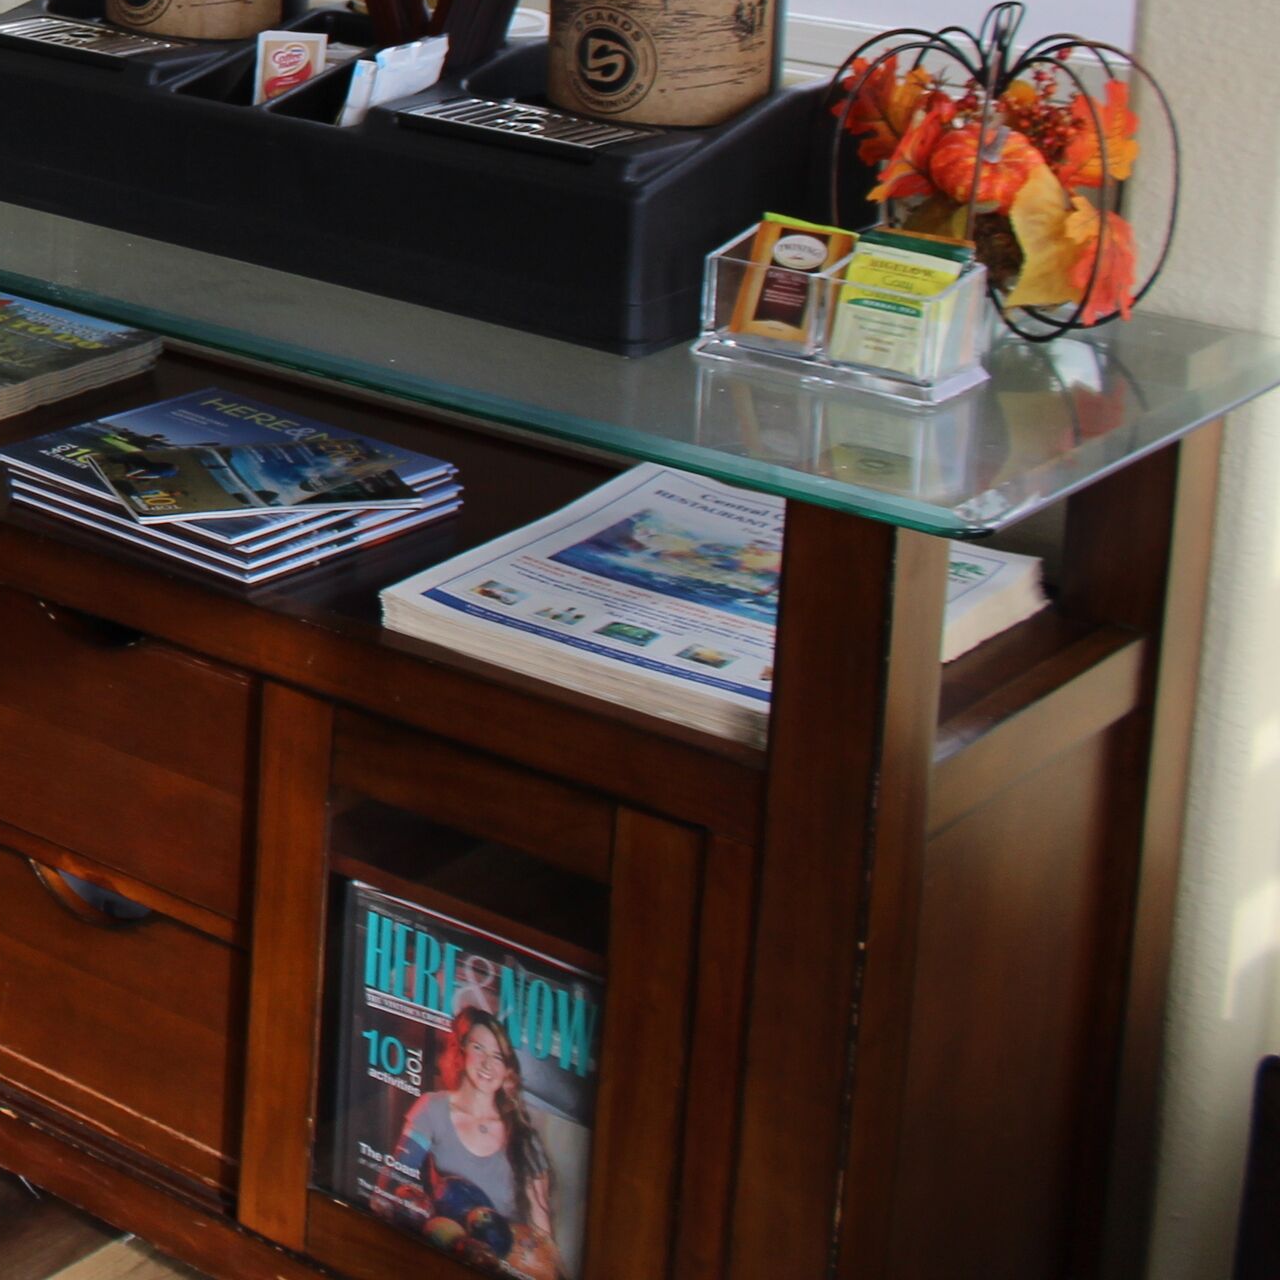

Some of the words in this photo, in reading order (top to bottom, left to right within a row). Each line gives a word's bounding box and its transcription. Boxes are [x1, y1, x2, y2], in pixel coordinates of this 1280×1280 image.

[701, 493, 769, 518] Central
[365, 911, 463, 1017] HERE
[498, 965, 598, 1077] NOW
[361, 1029, 406, 1076] 10
[406, 1048, 423, 1087] TOP
[367, 1067, 421, 1098] activities
[358, 1141, 383, 1162] The
[384, 1155, 421, 1181] Coast
